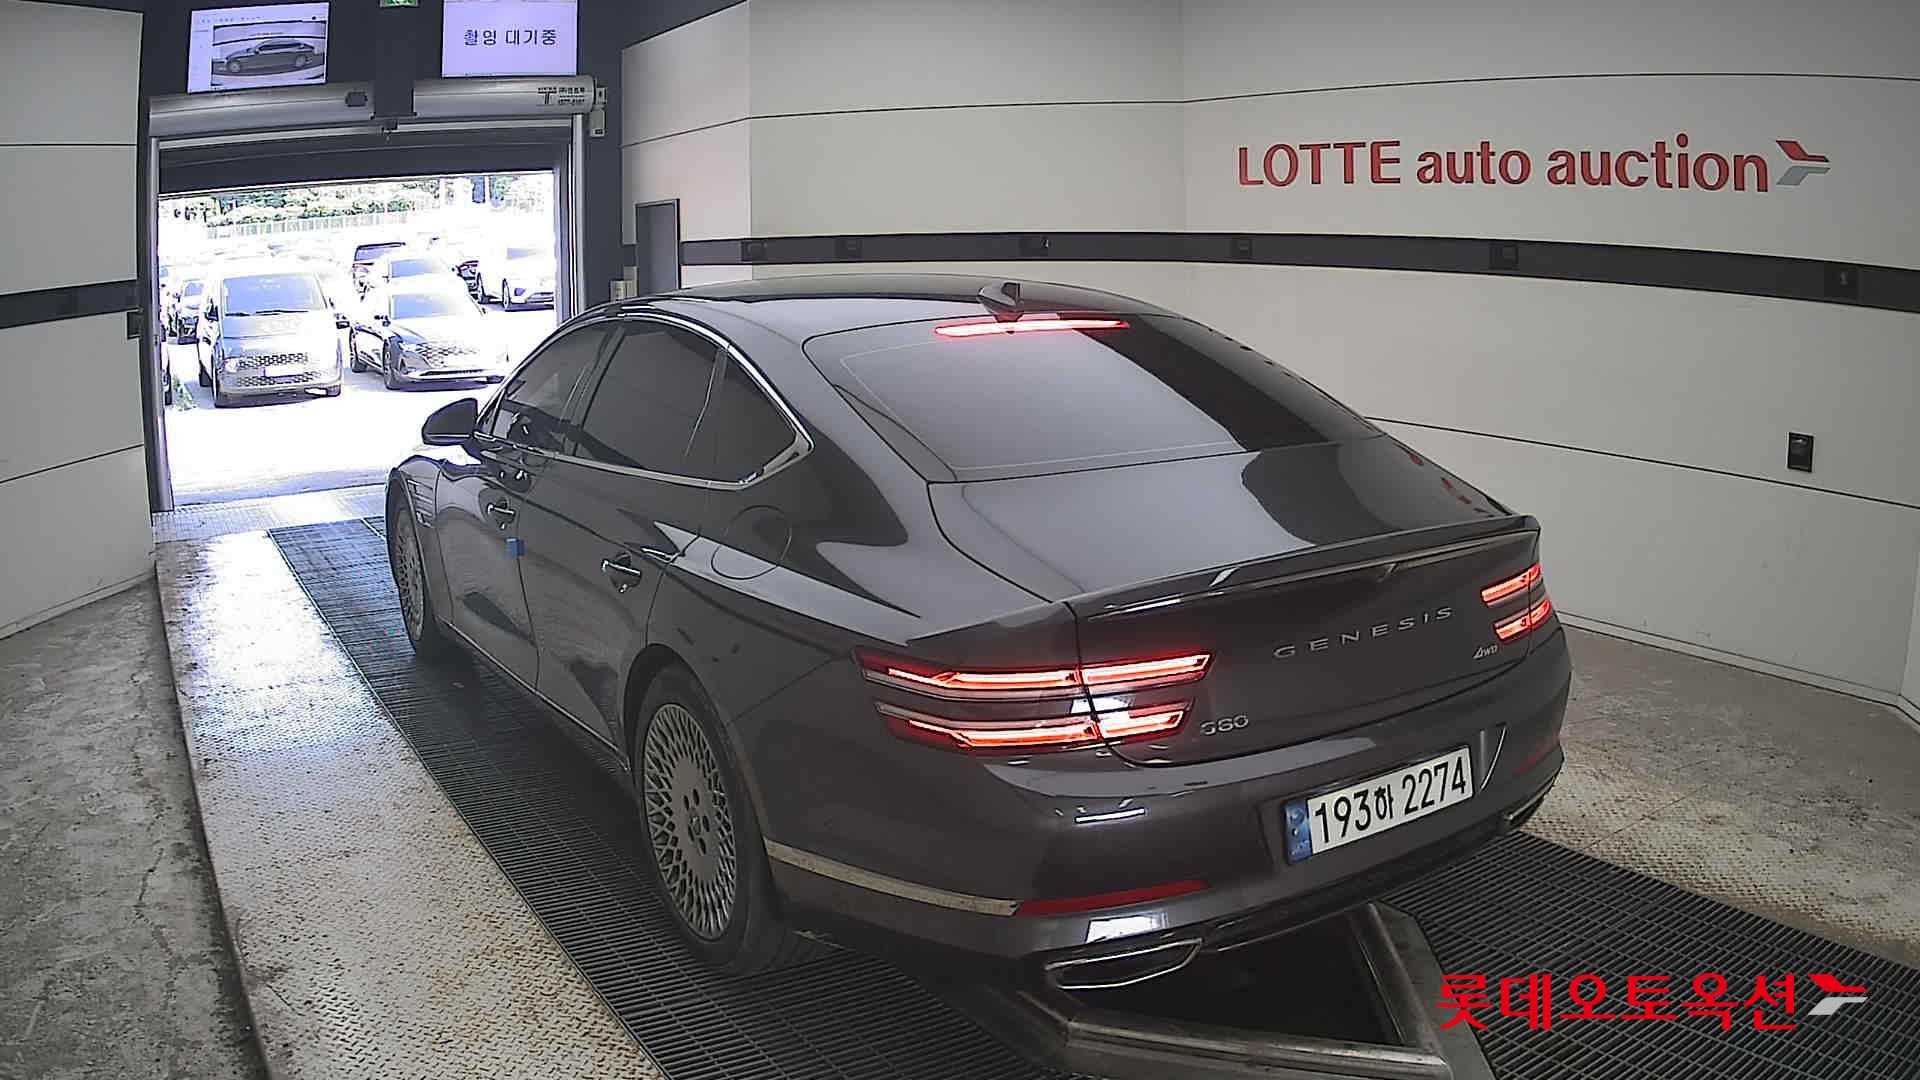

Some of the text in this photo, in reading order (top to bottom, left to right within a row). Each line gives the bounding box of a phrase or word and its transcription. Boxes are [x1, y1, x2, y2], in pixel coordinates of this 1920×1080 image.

[505, 29, 557, 46] 대기중
[1238, 133, 1769, 193] LOTTE auto auction
[1273, 606, 1454, 660] GENESIS
[1314, 756, 1467, 844] 193하 2274
